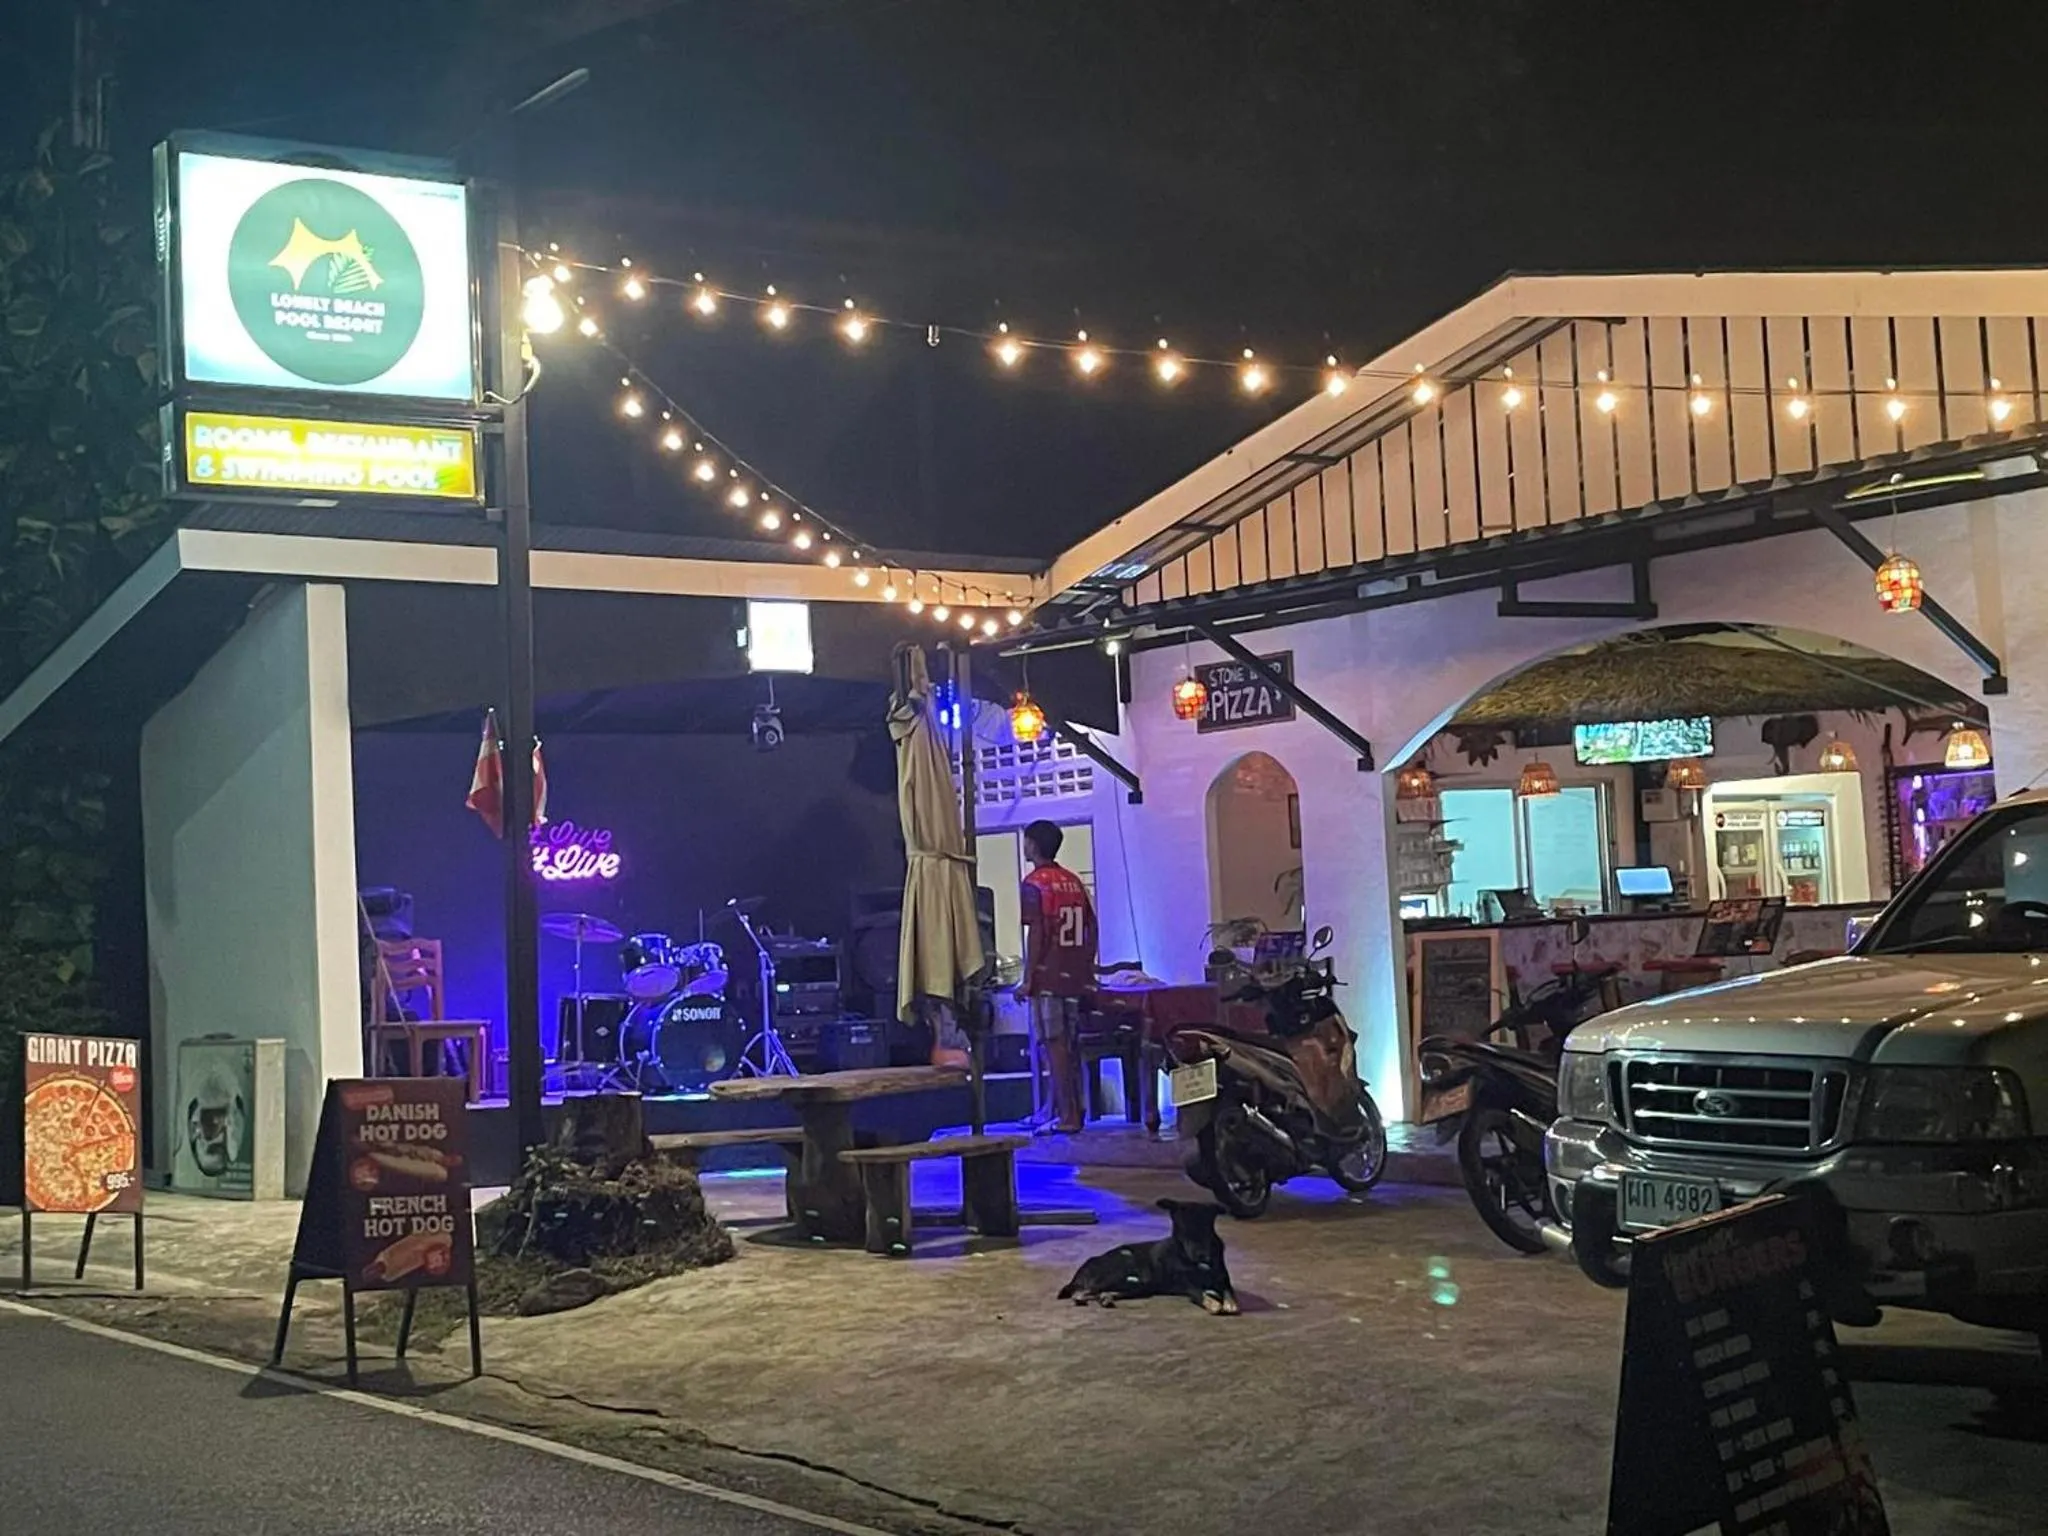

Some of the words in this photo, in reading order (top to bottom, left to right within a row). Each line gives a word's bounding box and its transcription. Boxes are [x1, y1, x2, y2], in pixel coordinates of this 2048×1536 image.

[194, 453, 215, 478] &
[1060, 906, 1083, 946] 21
[27, 1037, 82, 1065] GIANT
[87, 1041, 136, 1068] PIZZA
[366, 1103, 440, 1122] DANISH
[359, 1124, 401, 1142] HOT
[404, 1123, 449, 1141] DOG
[368, 1195, 448, 1216] FRENCH
[1664, 1183, 1712, 1213] 4982
[363, 1218, 407, 1238] HOT
[411, 1216, 455, 1235] DOG
